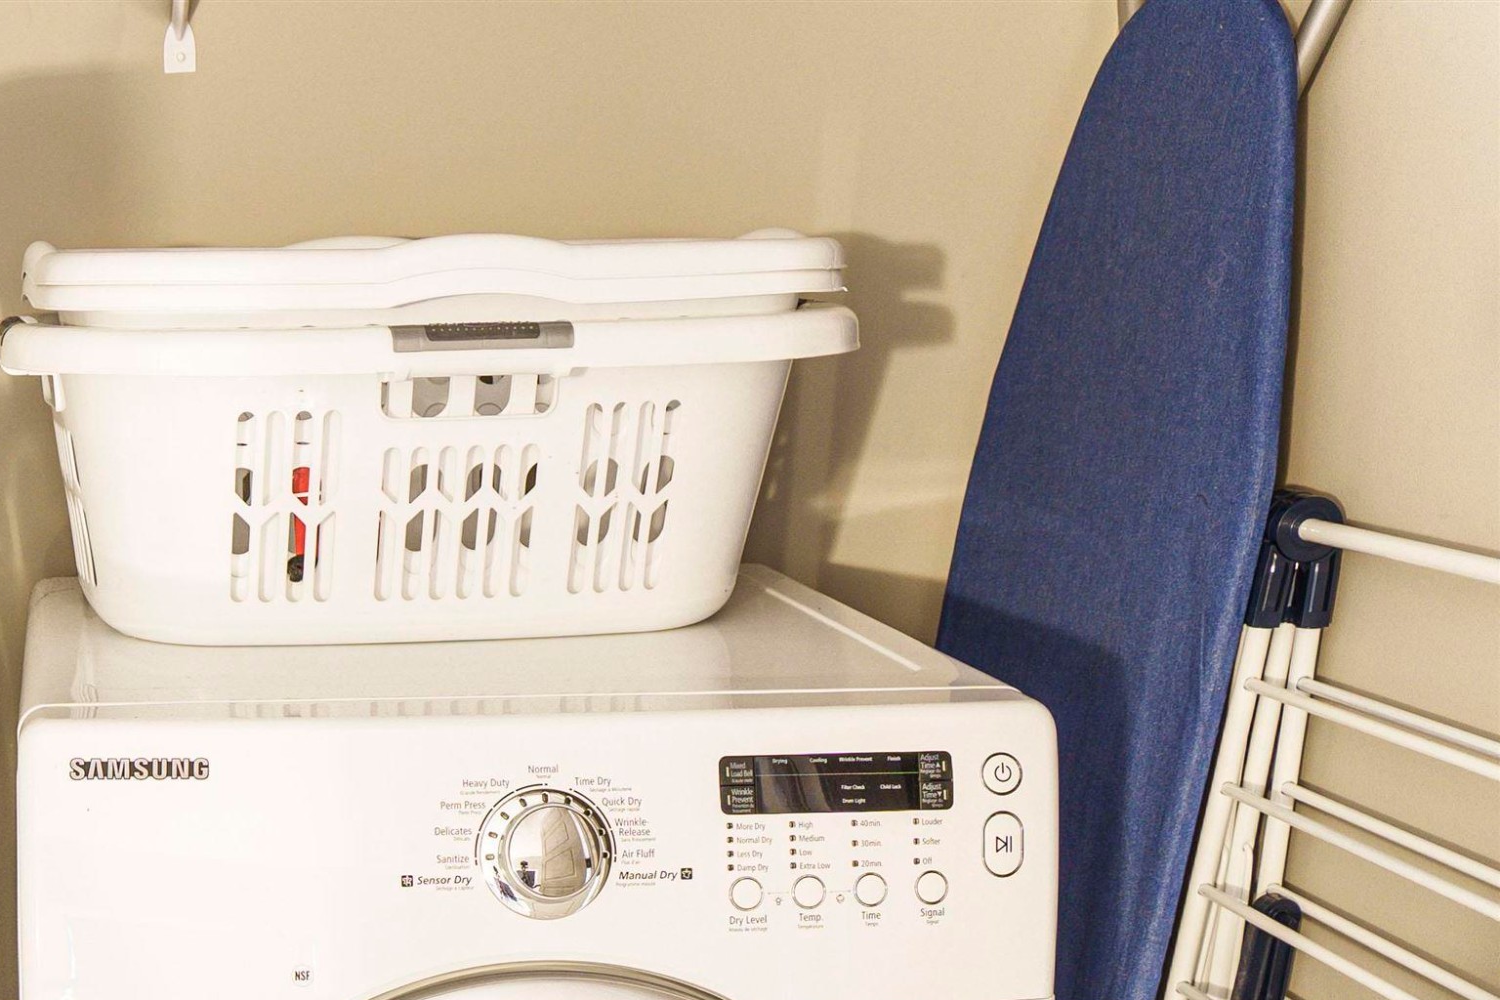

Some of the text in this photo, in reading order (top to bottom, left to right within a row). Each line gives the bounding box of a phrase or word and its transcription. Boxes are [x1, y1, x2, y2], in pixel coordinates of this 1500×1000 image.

[920, 754, 939, 762] Adjust
[69, 758, 209, 780] SAMSUNG
[528, 765, 558, 773] Normal
[463, 778, 510, 789] Heavy Duty
[575, 777, 611, 787] Time Dry
[922, 783, 942, 792] Adjust
[602, 797, 642, 807] Quick Dry
[732, 796, 754, 804] Prevent
[440, 801, 486, 810] Perm Press
[755, 823, 765, 831] Dry
[799, 821, 813, 829] High
[434, 827, 472, 836] Delicates
[619, 828, 650, 836] Release
[762, 836, 772, 845] Dry
[622, 849, 655, 858] Air Fluff
[752, 850, 763, 858] Dry
[436, 855, 470, 864] Sanitize
[737, 864, 769, 872] Damp Dry
[417, 875, 472, 886] Sensor Dry
[619, 871, 678, 881] Manual Dry
[862, 911, 881, 920] Time
[920, 908, 945, 918] Signal
[729, 915, 767, 926] Dry Level
[295, 971, 310, 981] NSF
